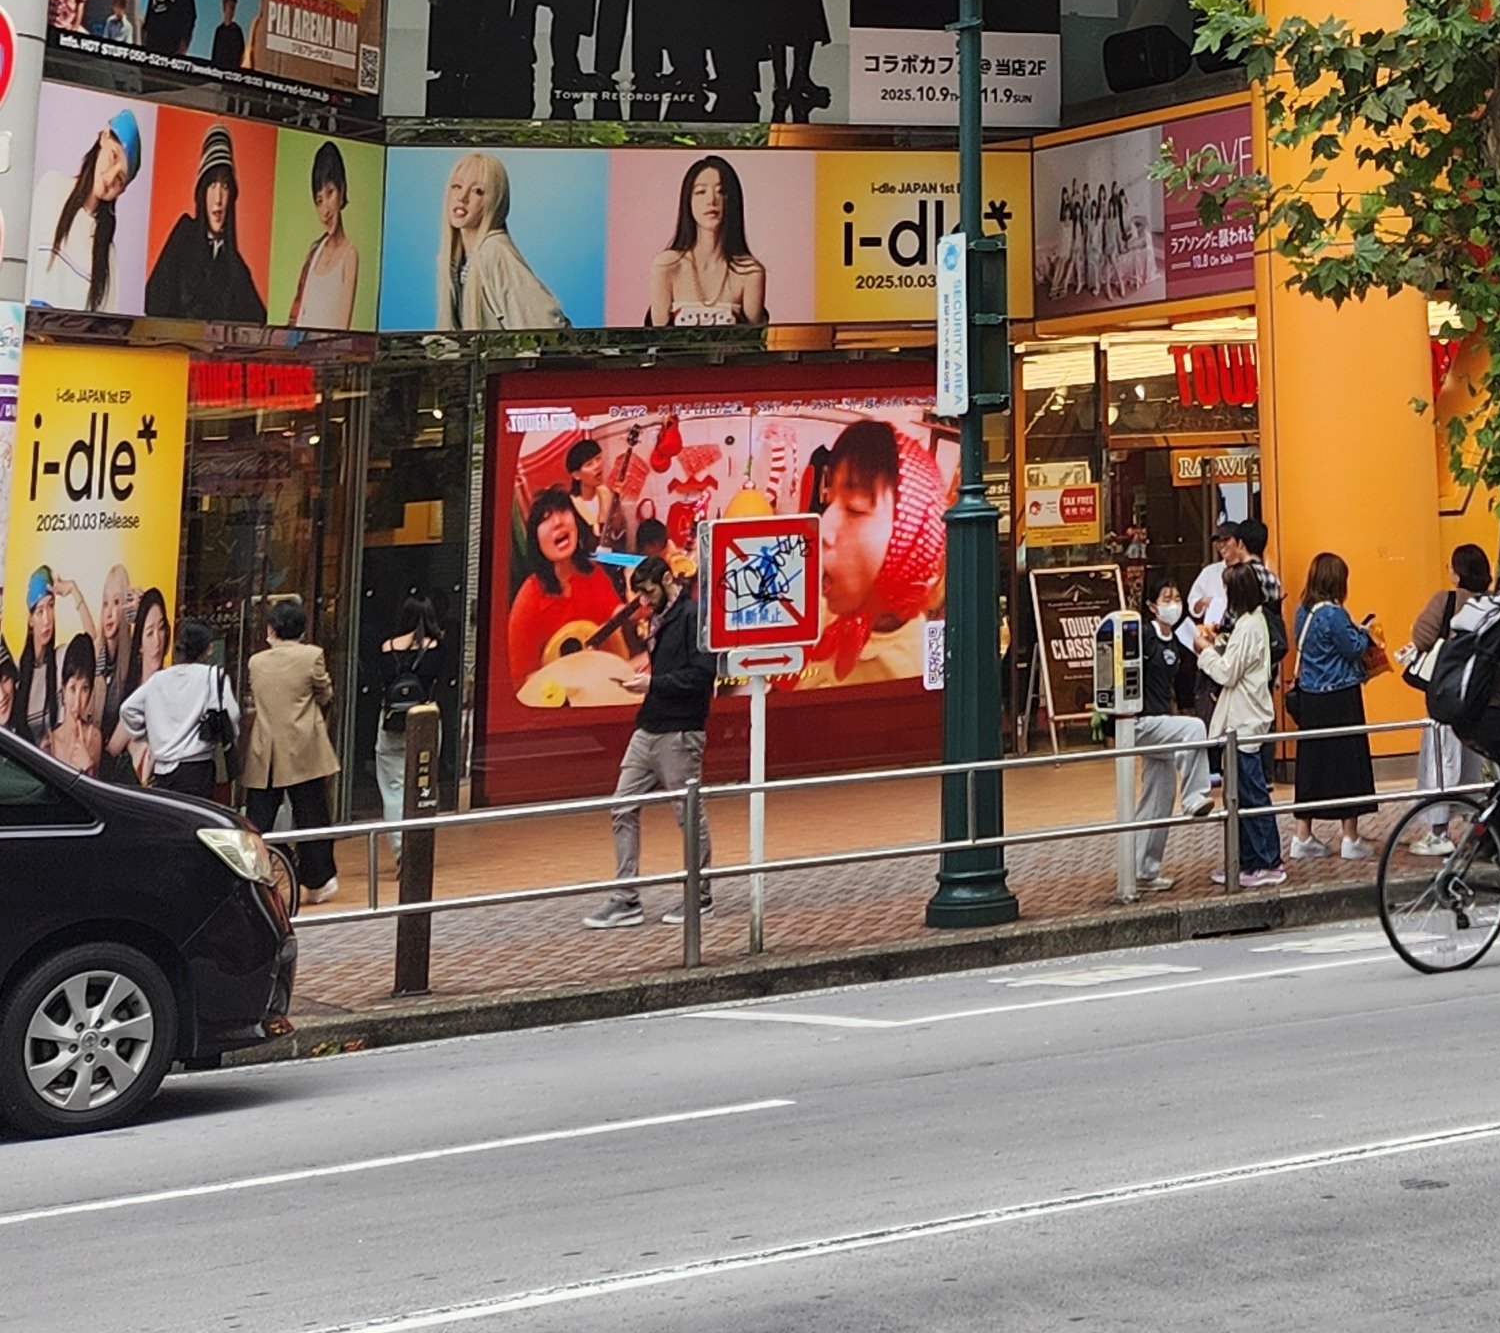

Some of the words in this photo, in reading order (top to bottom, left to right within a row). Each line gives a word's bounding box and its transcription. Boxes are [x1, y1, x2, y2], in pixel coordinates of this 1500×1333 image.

[267, 0, 291, 37] PIA
[292, 8, 333, 48] ARENA
[80, 37, 100, 52] HOT
[101, 41, 129, 58] STUFF
[864, 53, 961, 76] コラボカフ
[871, 183, 896, 194] i-dle
[898, 183, 937, 194] JAPAN
[939, 183, 955, 194] 1st
[1210, 255, 1219, 266] On
[1219, 253, 1234, 265] Sale
[855, 275, 937, 289] 2025.10.03
[953, 278, 963, 358] SECURITY
[953, 361, 964, 406] AREA
[76, 389, 107, 403] JAPAN
[119, 390, 132, 404] EP
[35, 512, 98, 532] 2025.10.03
[99, 511, 140, 531] Release
[730, 608, 784, 625] 横断禁止
